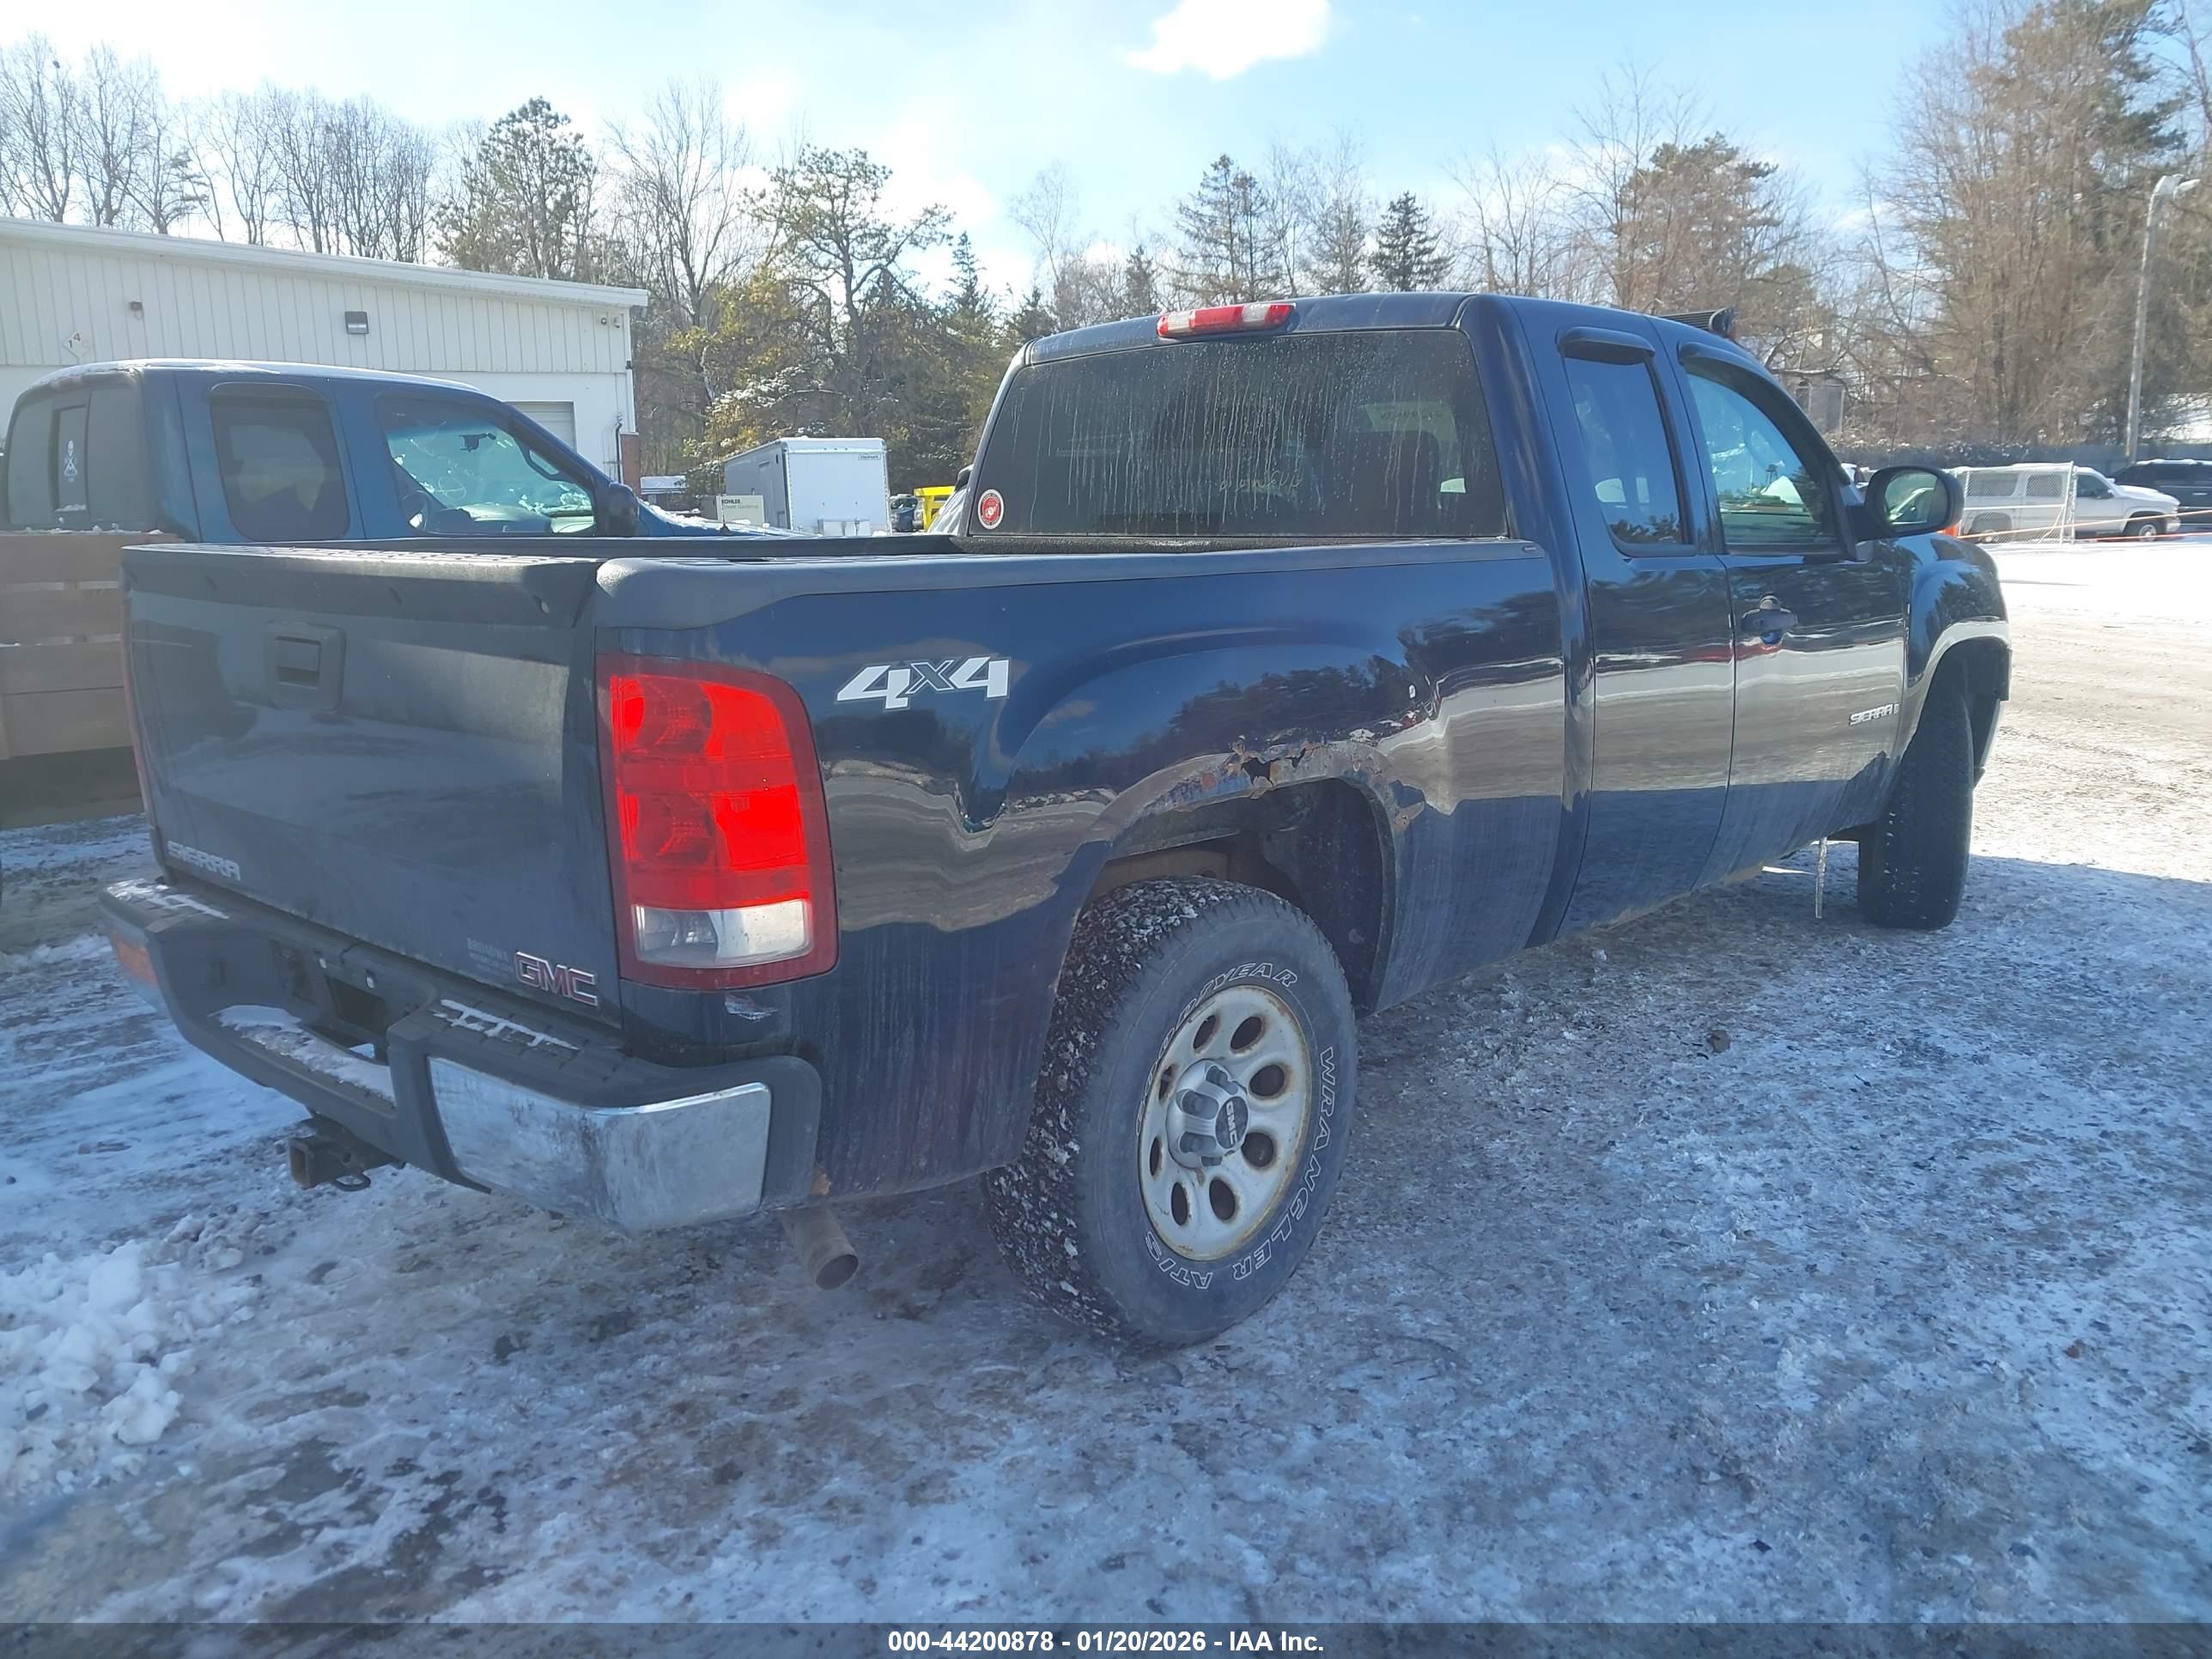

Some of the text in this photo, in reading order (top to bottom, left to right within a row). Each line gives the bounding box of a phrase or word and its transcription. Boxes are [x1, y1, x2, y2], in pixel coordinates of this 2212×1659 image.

[1850, 704, 1893, 726] SIERRA
[167, 841, 240, 881] SIERRA
[515, 951, 598, 1006] GMC
[1226, 1101, 1237, 1145] GMC
[1232, 1047, 1335, 1280] WRANGLER
